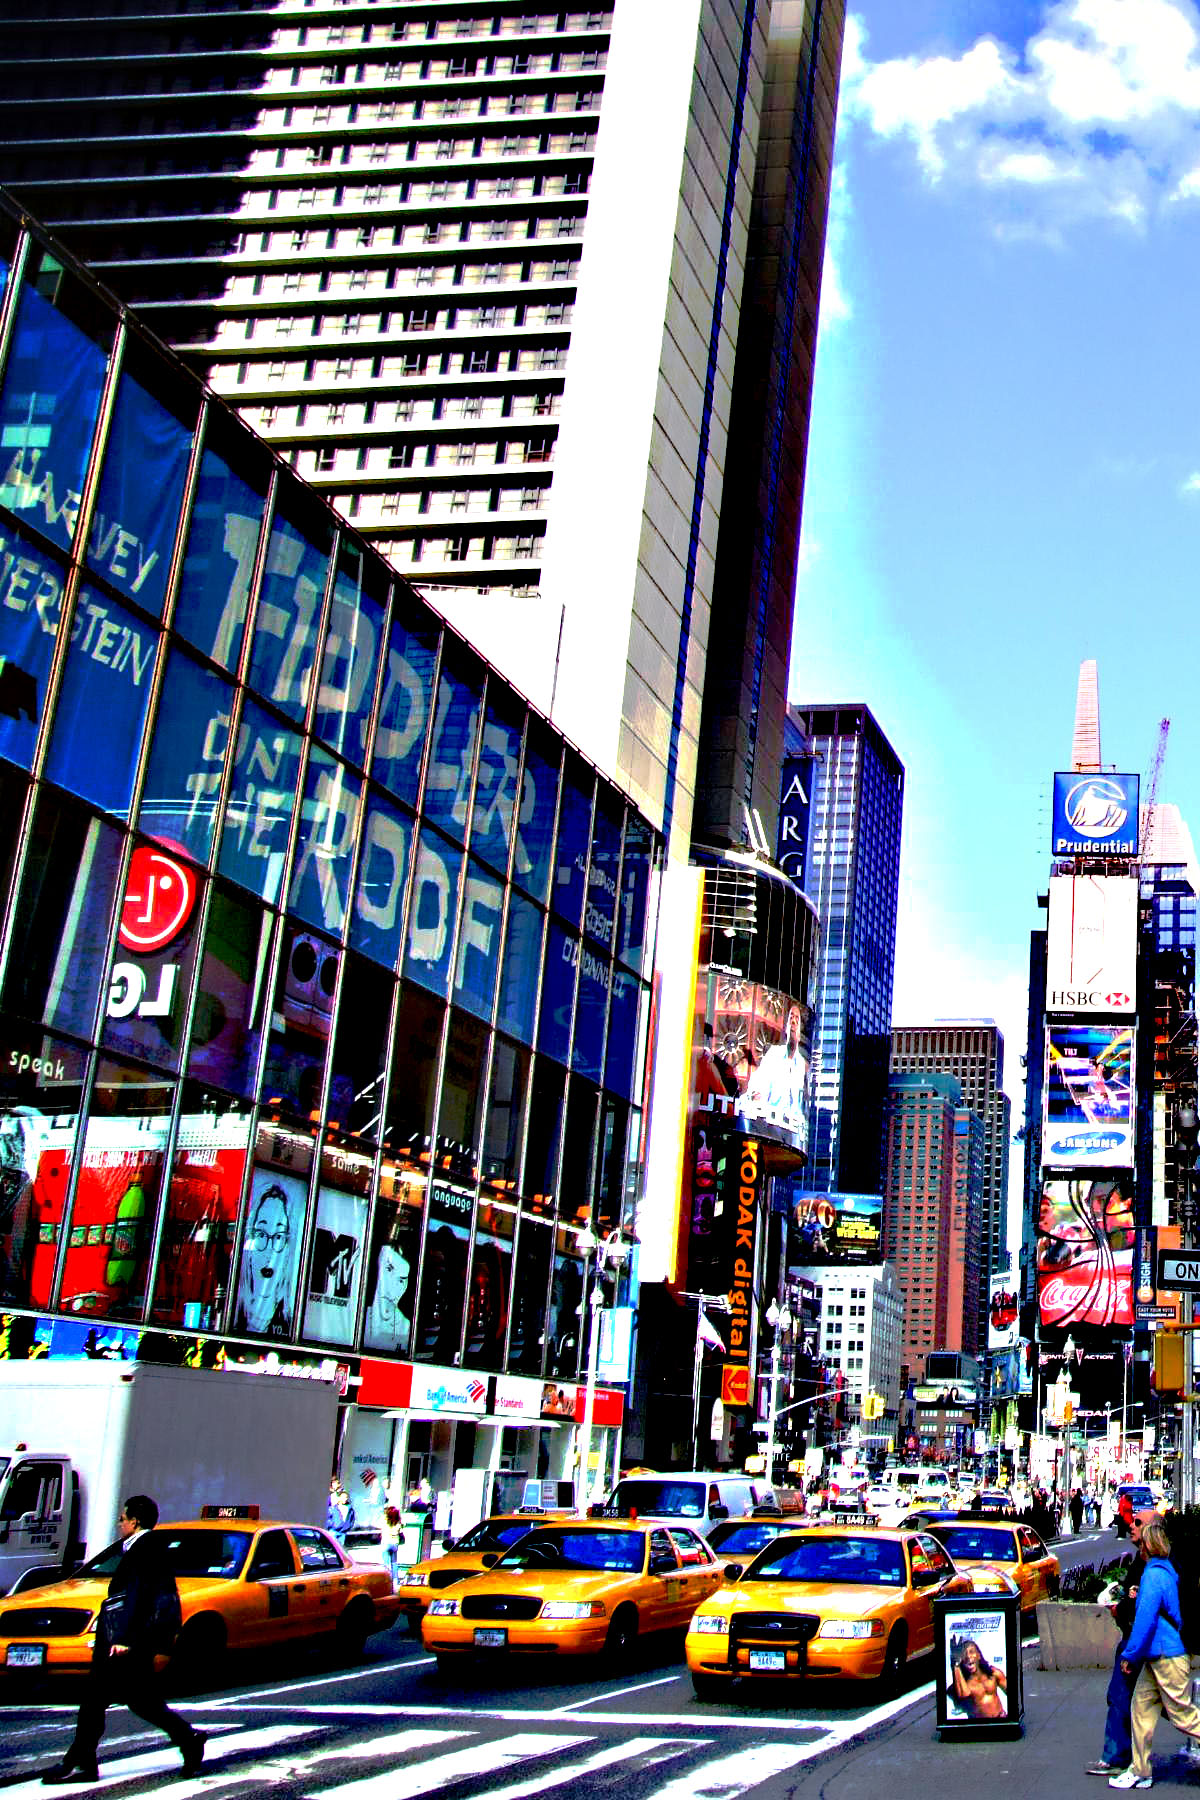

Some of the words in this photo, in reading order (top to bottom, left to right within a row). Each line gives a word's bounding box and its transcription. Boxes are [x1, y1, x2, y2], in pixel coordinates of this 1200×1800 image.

[2, 448, 160, 593] HARVEY
[0, 537, 154, 686] IERSTEIN
[210, 512, 537, 875] FIDDLER
[202, 710, 286, 783] ON
[183, 772, 290, 859] THE
[1056, 838, 1134, 854] Prudential
[288, 769, 503, 962] ROOF
[1051, 991, 1102, 1006] HSBC
[9, 1050, 65, 1081] speak
[1063, 1047, 1078, 1056] TILT
[1058, 1137, 1119, 1149] SAMSUNG
[736, 1140, 760, 1249] KODAK
[310, 1227, 362, 1299] MTV
[1140, 1262, 1152, 1297] DESIGN
[728, 1258, 752, 1358] digital
